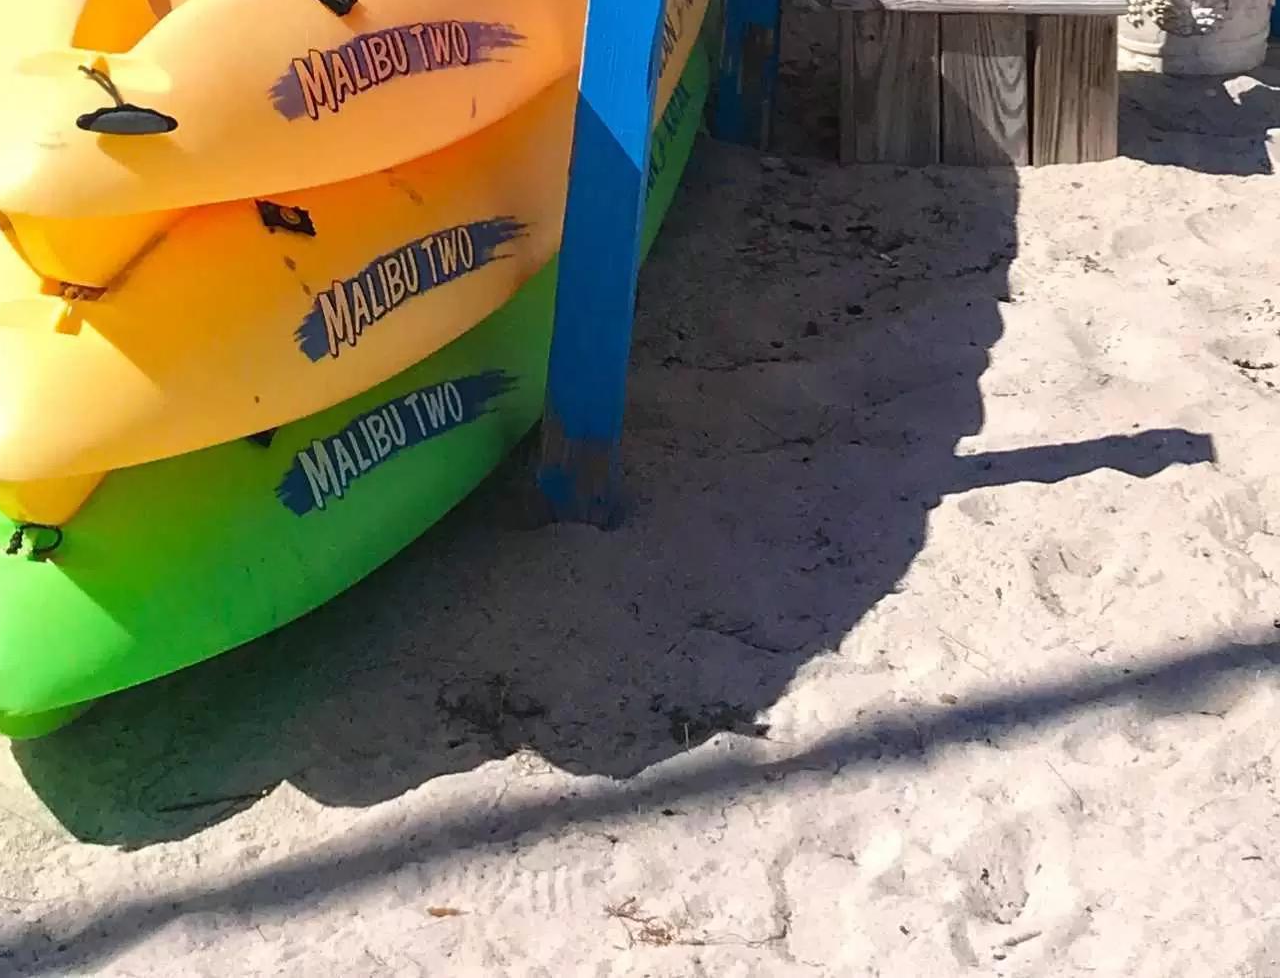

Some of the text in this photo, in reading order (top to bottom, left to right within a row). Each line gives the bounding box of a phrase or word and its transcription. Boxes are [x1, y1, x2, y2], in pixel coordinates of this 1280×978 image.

[292, 20, 471, 120] MALIBU TWO
[319, 225, 474, 358] MALIBU TWO
[297, 380, 464, 511] MALIBU TWO
